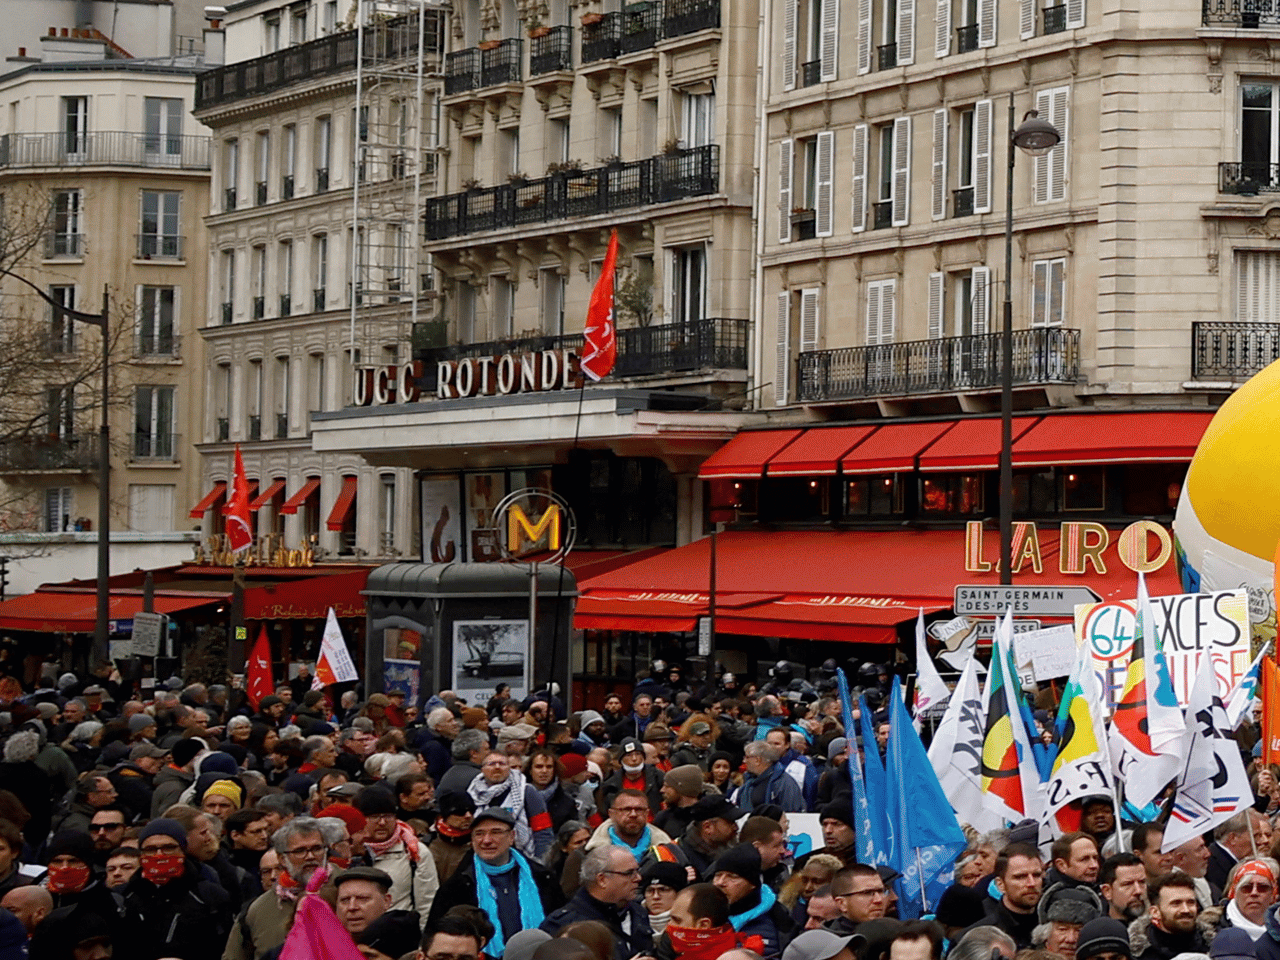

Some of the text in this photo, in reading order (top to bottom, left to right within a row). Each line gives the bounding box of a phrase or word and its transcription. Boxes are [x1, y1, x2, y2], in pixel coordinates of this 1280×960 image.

[437, 349, 577, 399] ROTONDE
[508, 504, 561, 551] M
[961, 590, 1063, 599] SAINT GERMAIN
[1090, 607, 1132, 655] 64
